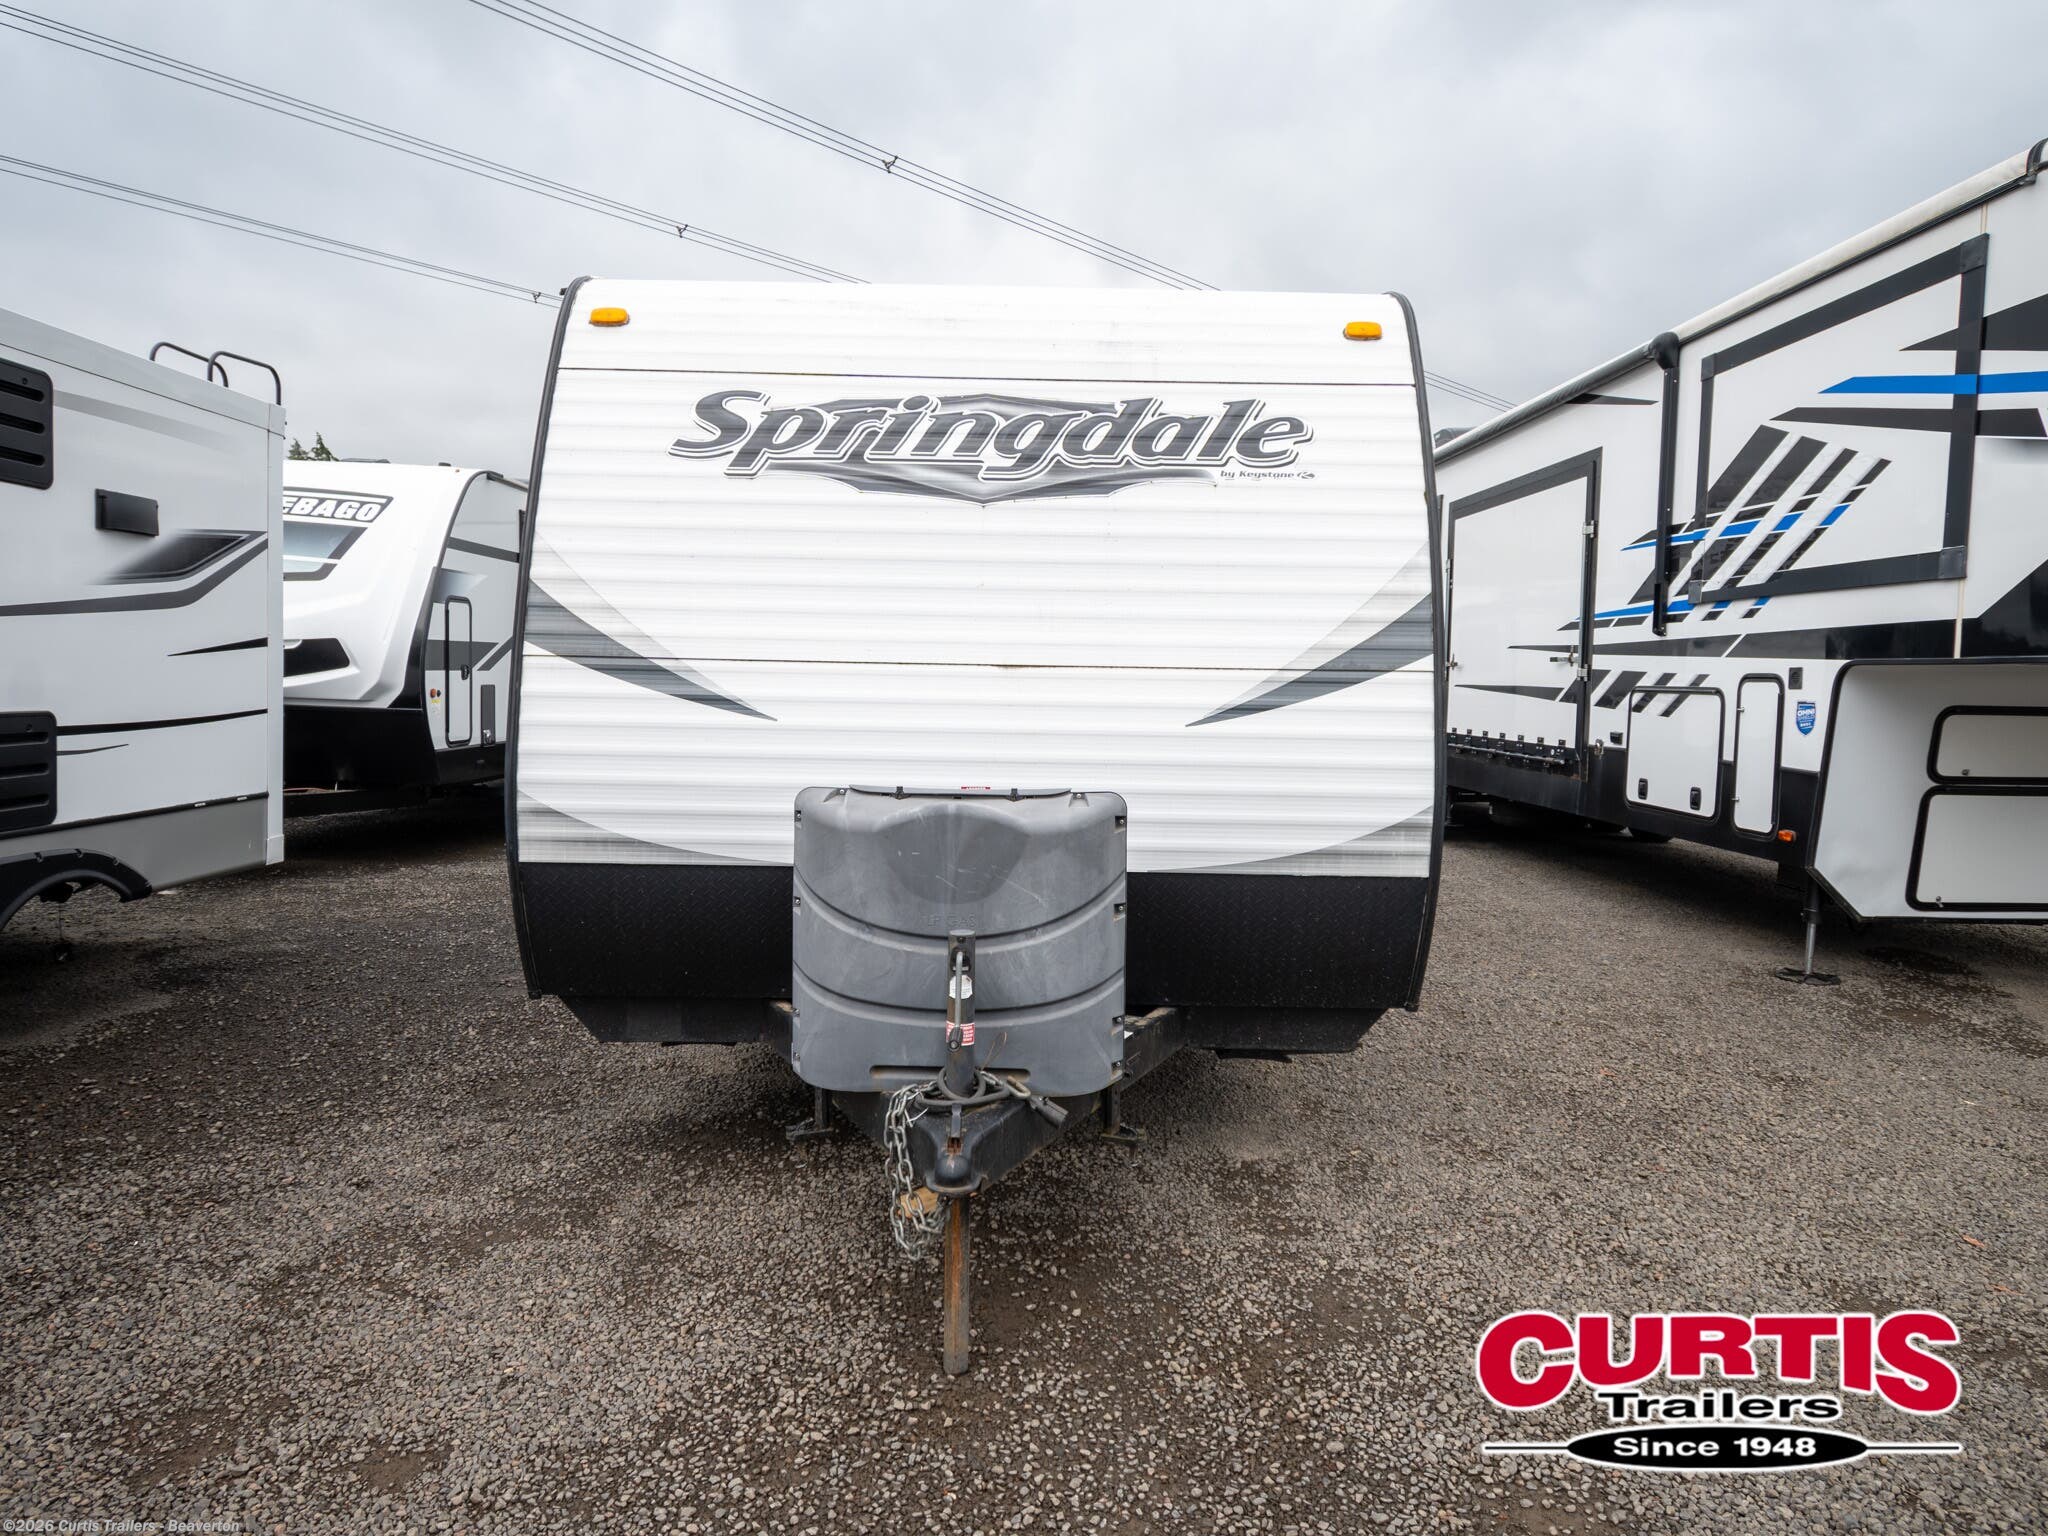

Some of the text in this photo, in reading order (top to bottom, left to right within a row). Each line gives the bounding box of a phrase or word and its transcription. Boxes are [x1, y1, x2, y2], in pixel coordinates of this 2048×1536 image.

[666, 390, 1314, 482] Springdale
[1220, 470, 1295, 480] by Keystone
[282, 495, 381, 521] EBAGO
